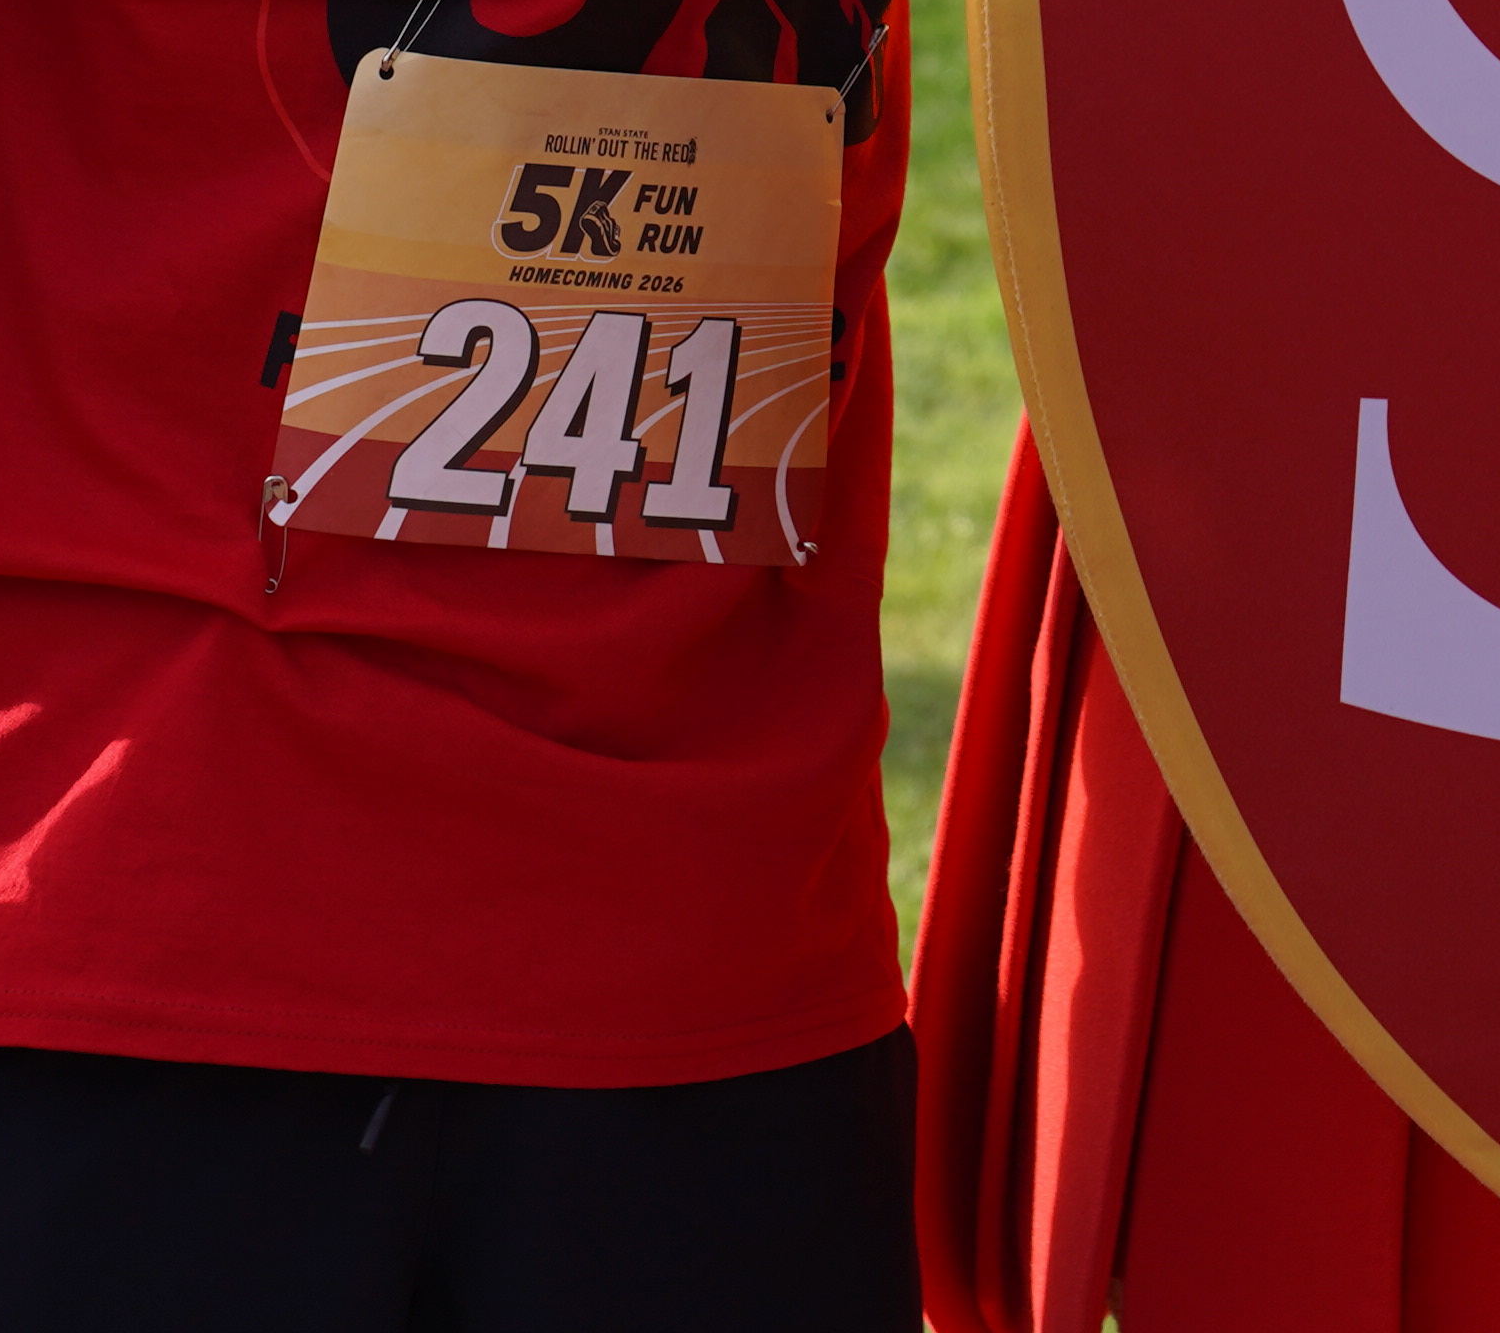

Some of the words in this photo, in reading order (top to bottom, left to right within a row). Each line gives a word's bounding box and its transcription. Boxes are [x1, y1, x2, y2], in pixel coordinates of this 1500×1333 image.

[545, 134, 596, 156] ROLLIN'
[597, 138, 629, 158] OUT
[634, 141, 661, 161] THE
[662, 143, 690, 163] RED
[599, 128, 621, 137] STAN
[623, 129, 649, 139] STATE
[500, 163, 633, 257] 5K
[633, 184, 698, 216] FUN
[637, 223, 703, 255] RUN
[509, 265, 633, 290] HOMECOMING
[638, 274, 684, 293] 2026
[386, 297, 742, 532] 241
